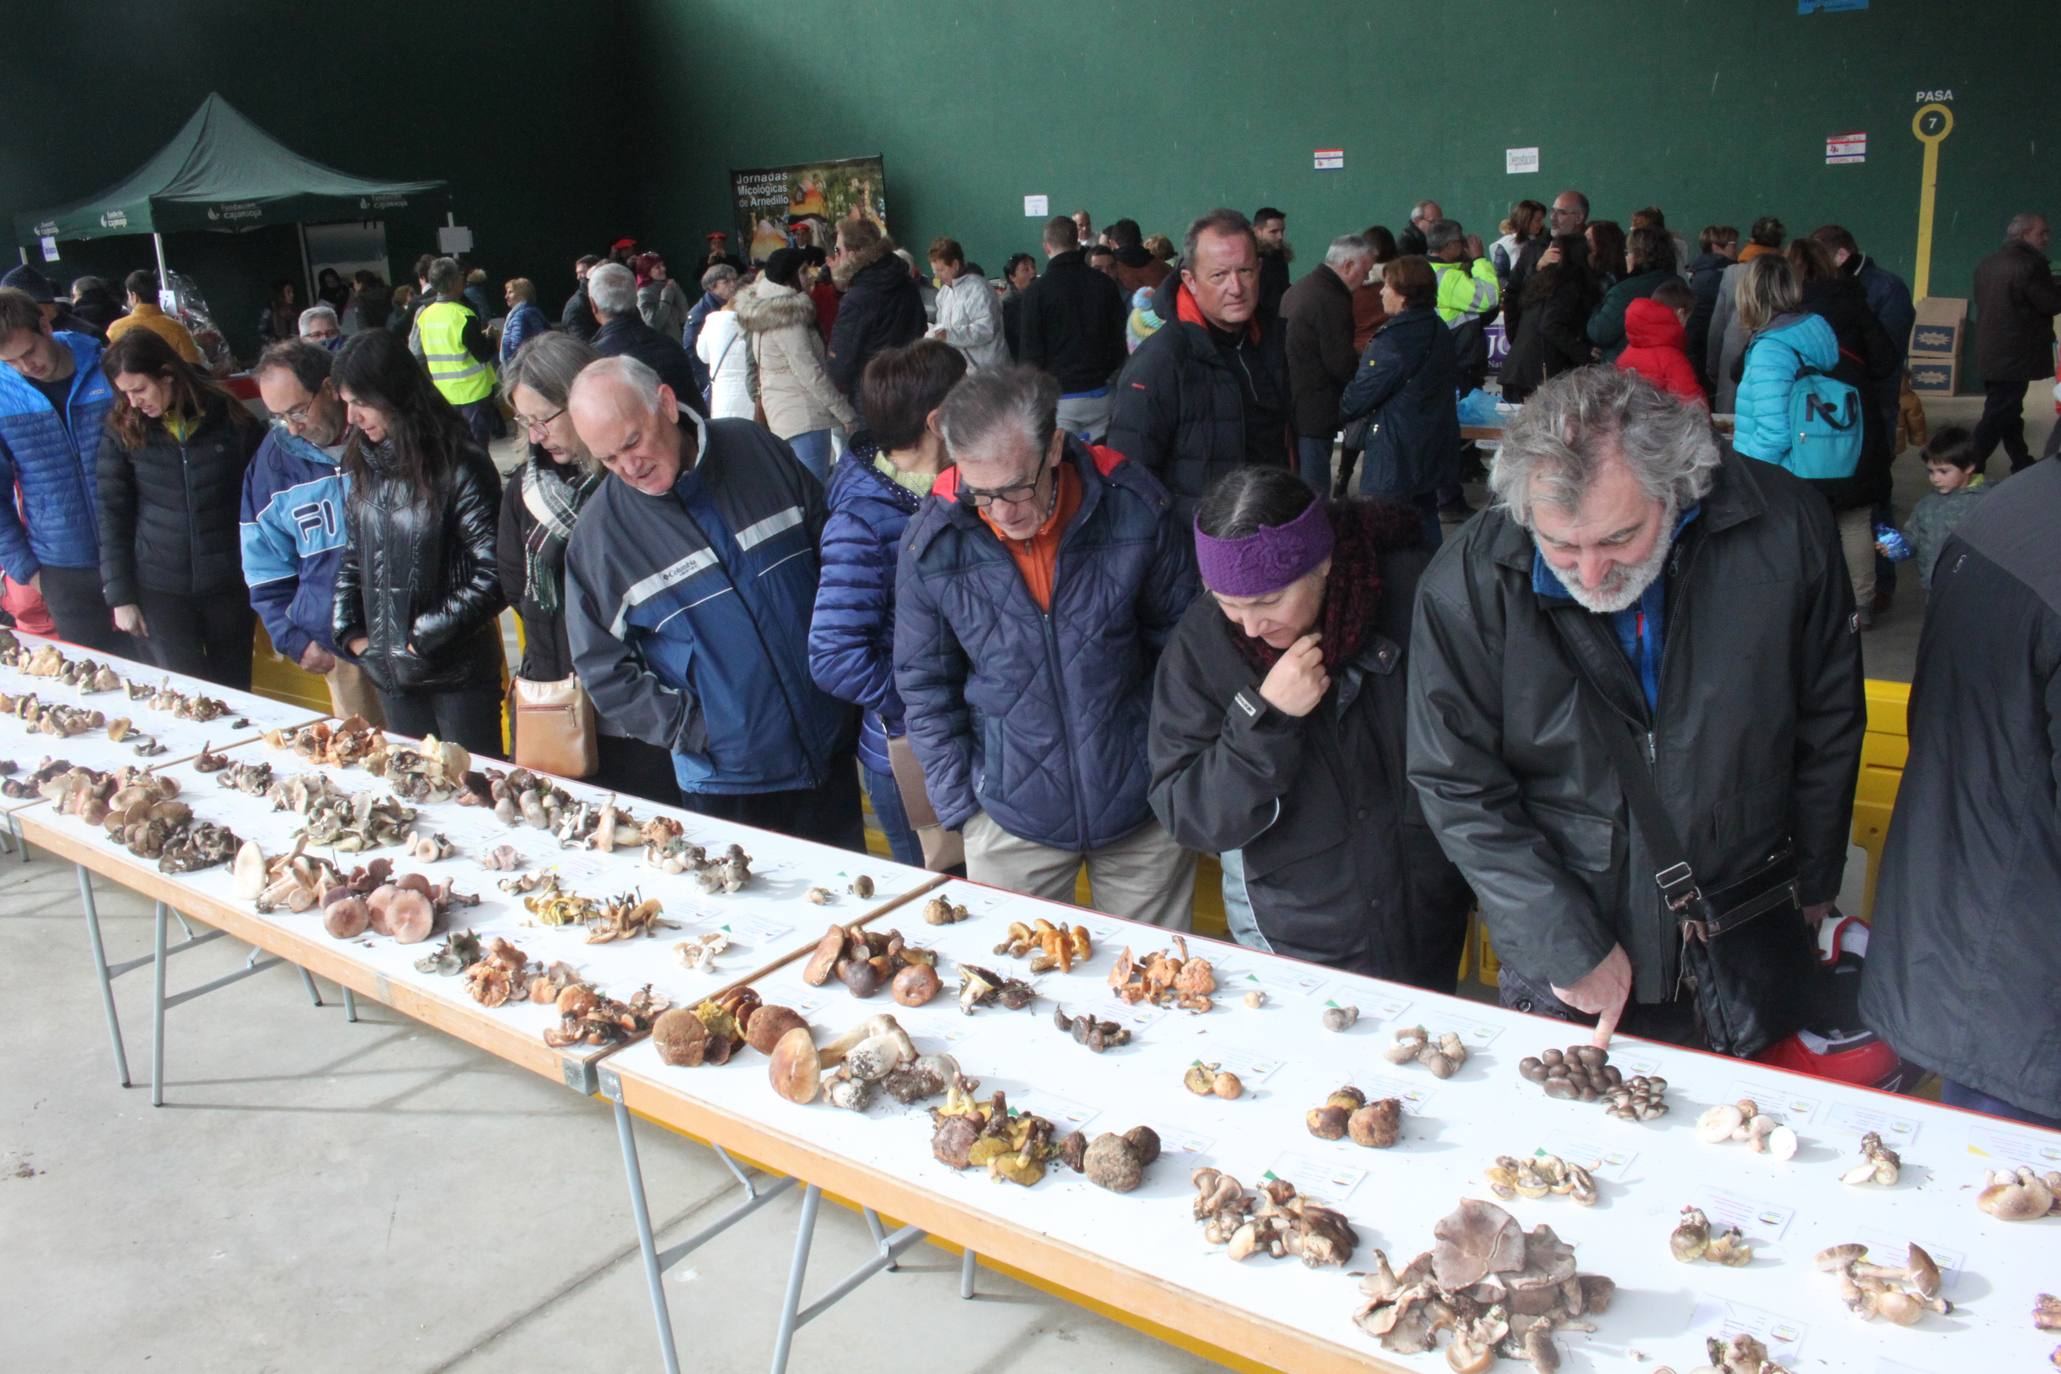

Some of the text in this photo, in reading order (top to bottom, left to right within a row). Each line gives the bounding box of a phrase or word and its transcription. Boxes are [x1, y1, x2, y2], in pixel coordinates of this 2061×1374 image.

[1915, 89, 1954, 103] PASA
[1928, 117, 1938, 129] 7
[736, 172, 789, 185] Jornadas
[750, 194, 790, 208] Arnedillo
